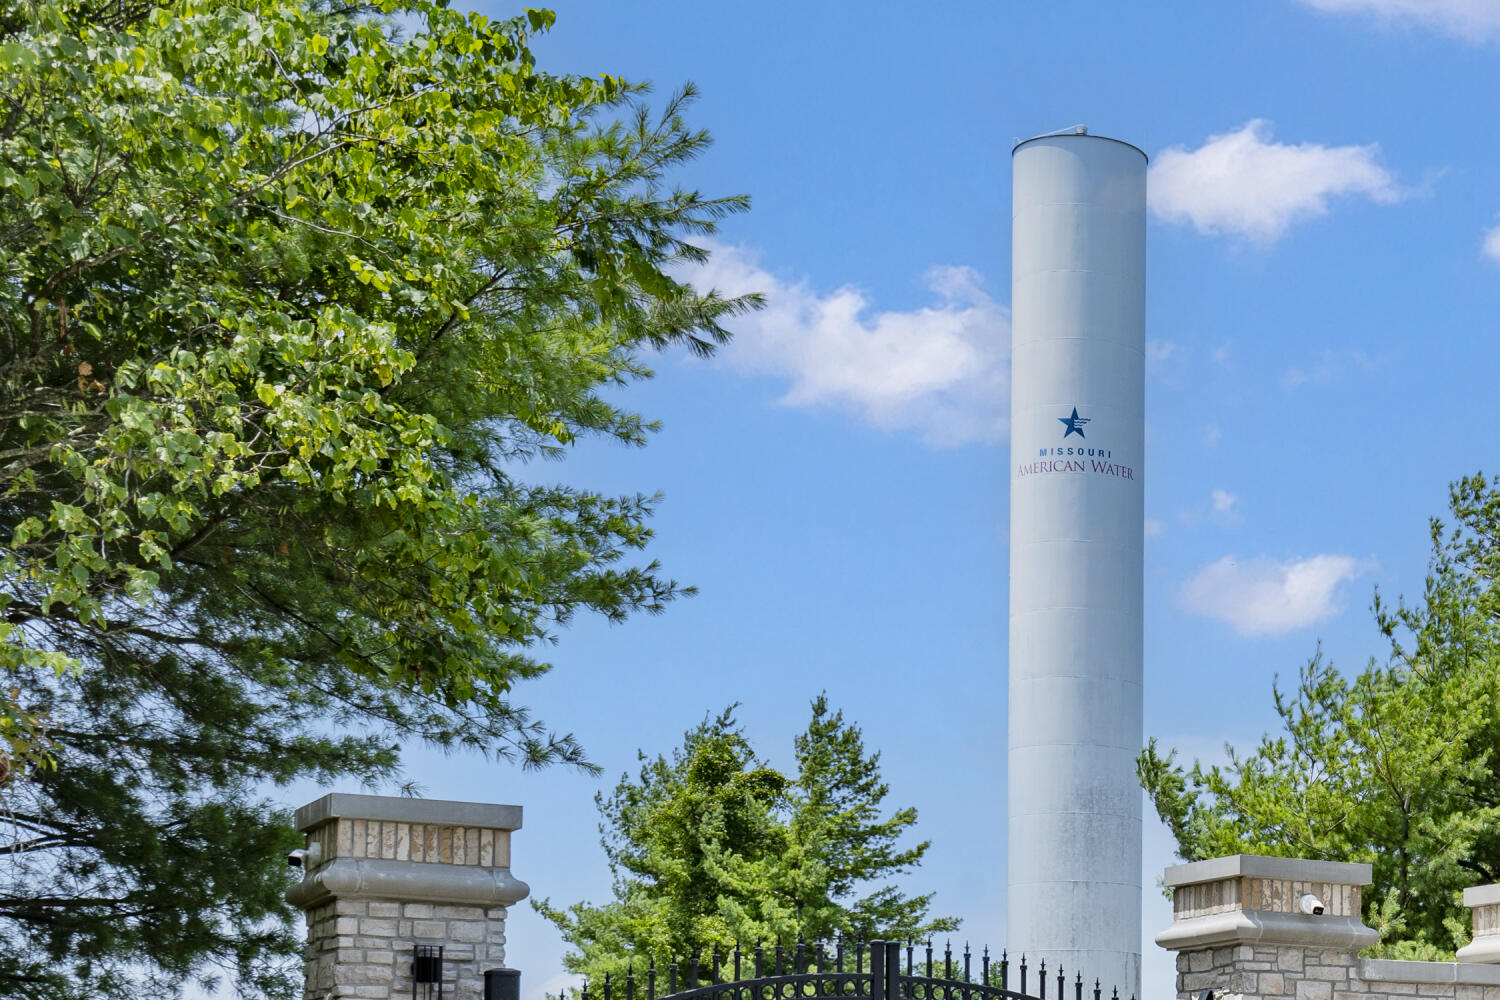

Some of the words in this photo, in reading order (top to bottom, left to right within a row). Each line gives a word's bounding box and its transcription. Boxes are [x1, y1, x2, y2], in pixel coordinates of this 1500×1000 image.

[1039, 447, 1111, 459] MISSOURI
[1017, 459, 1085, 478] AMERICAN
[1091, 459, 1134, 480] WATER
